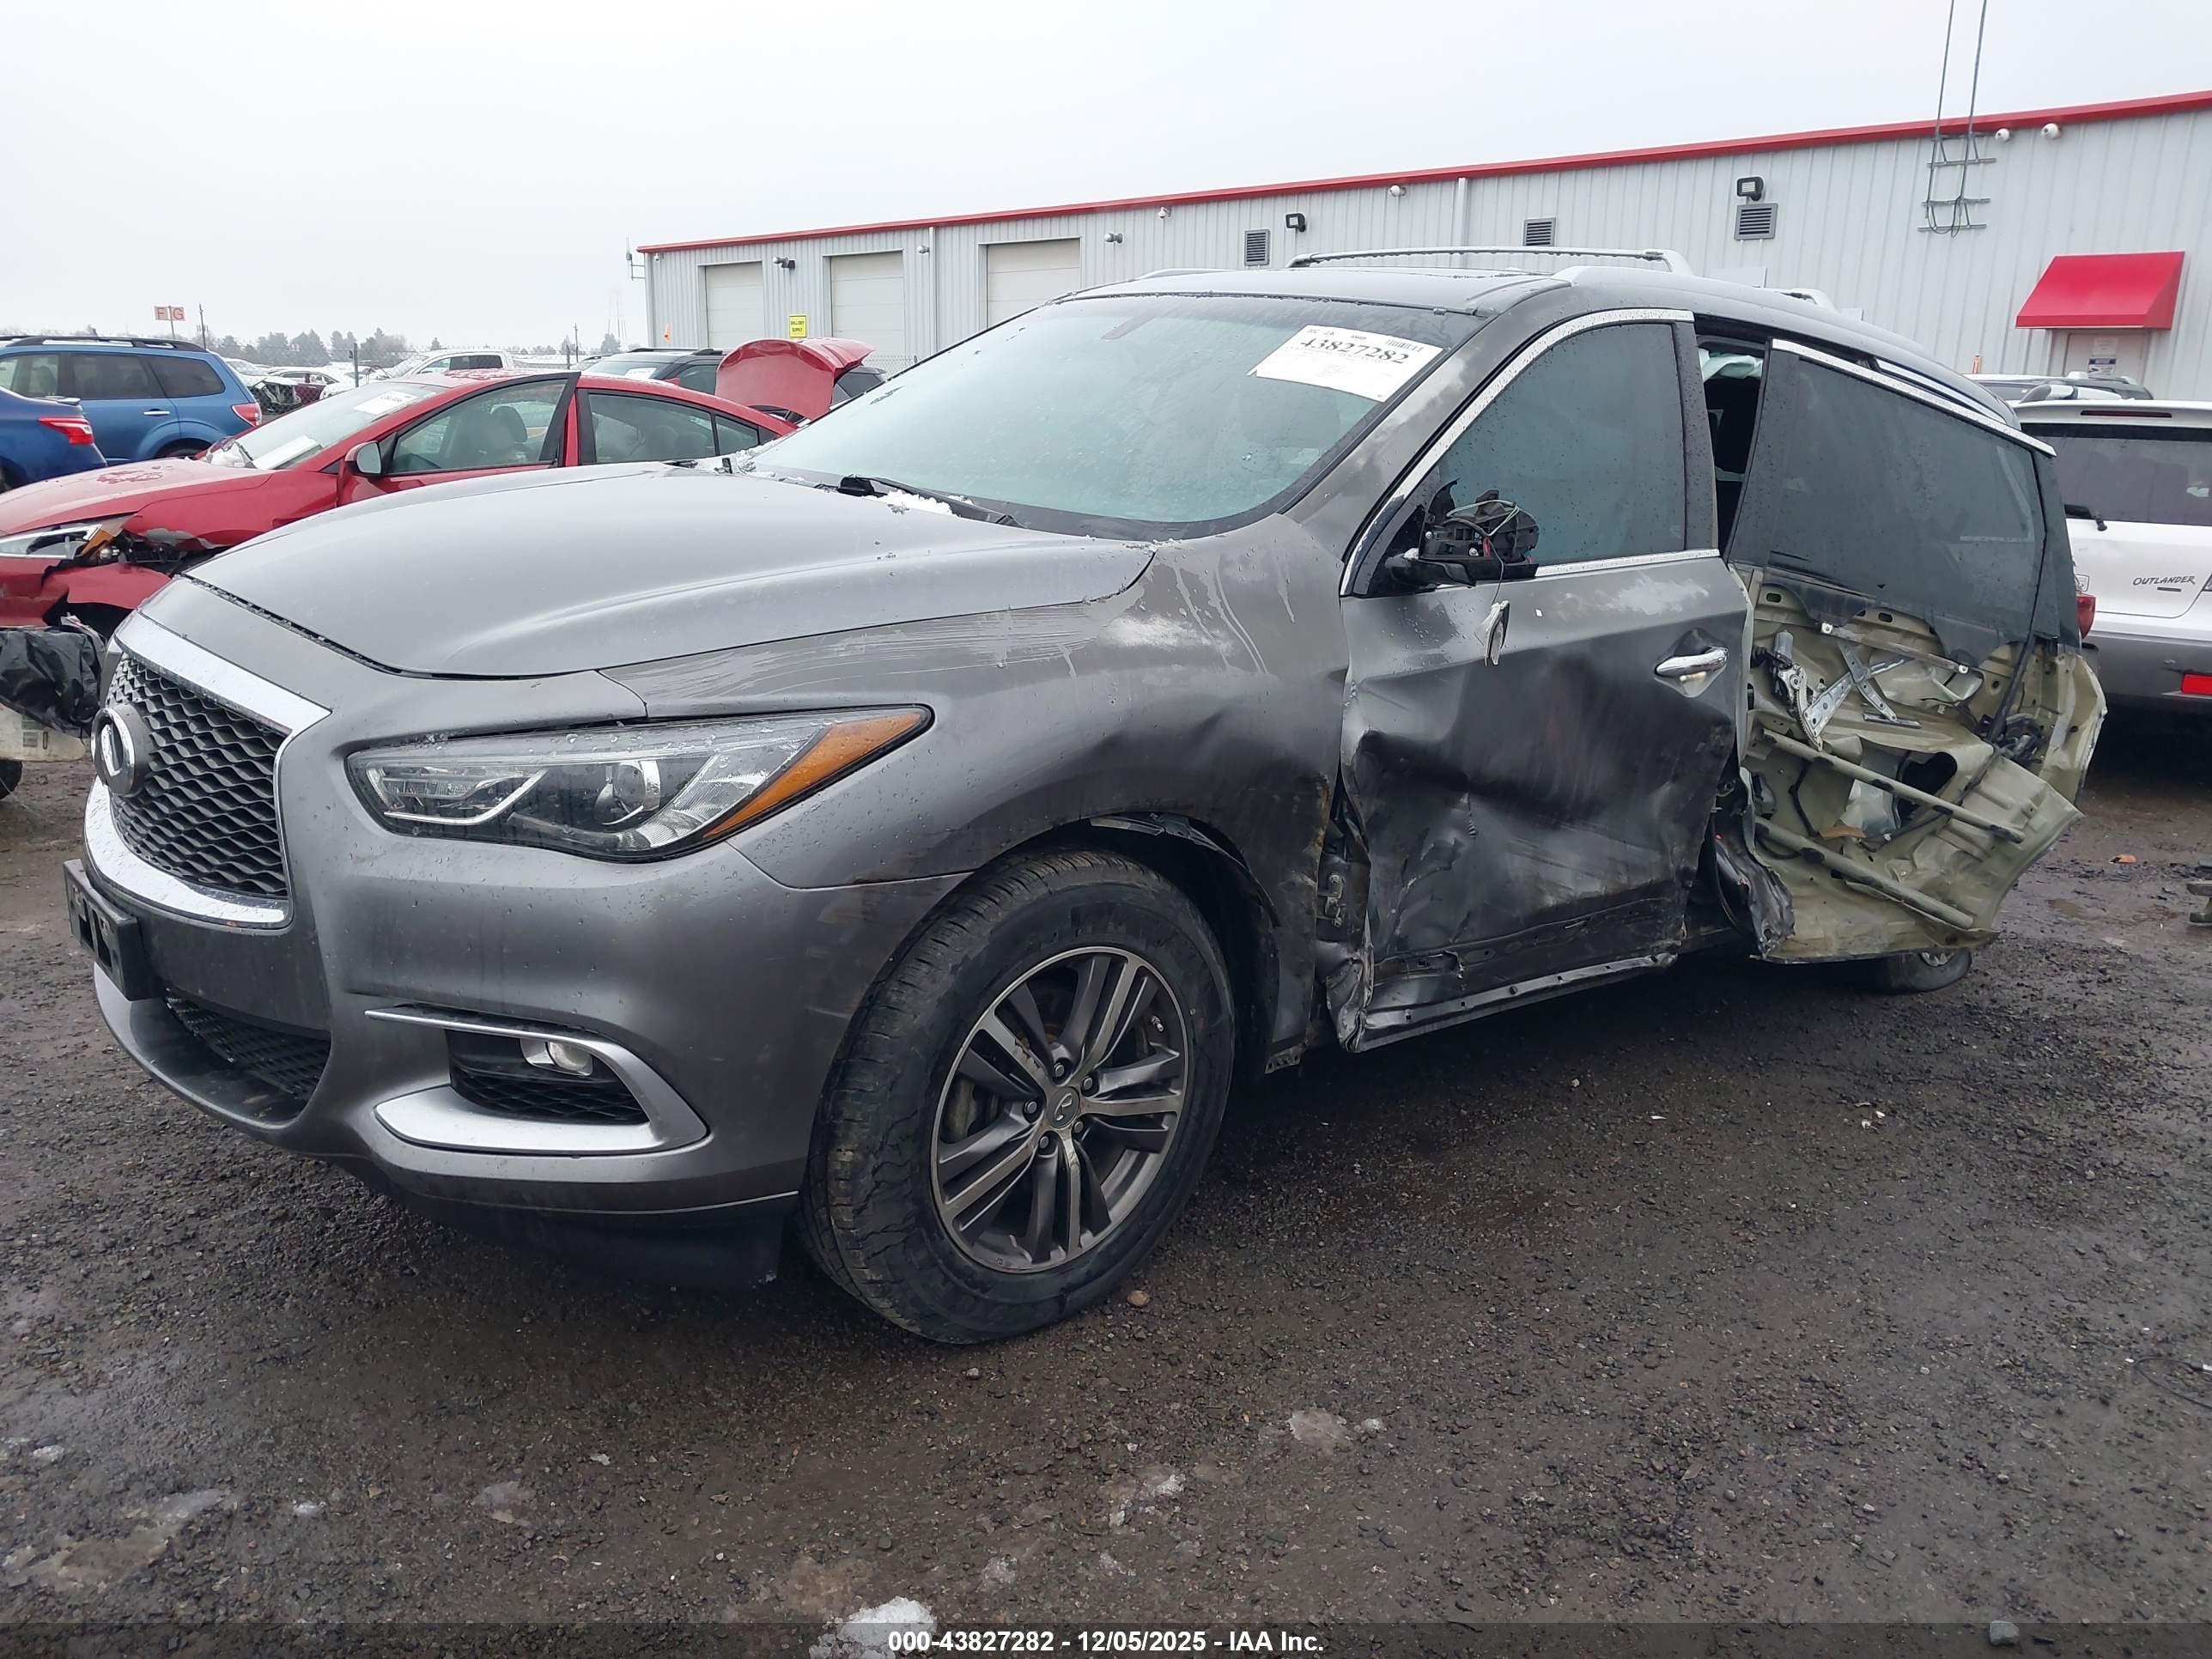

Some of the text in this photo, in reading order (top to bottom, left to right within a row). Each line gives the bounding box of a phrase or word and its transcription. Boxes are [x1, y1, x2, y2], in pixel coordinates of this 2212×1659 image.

[173, 307, 185, 320] G
[1300, 337, 1410, 364] 43827282
[2133, 575, 2196, 586] OUTLANDER
